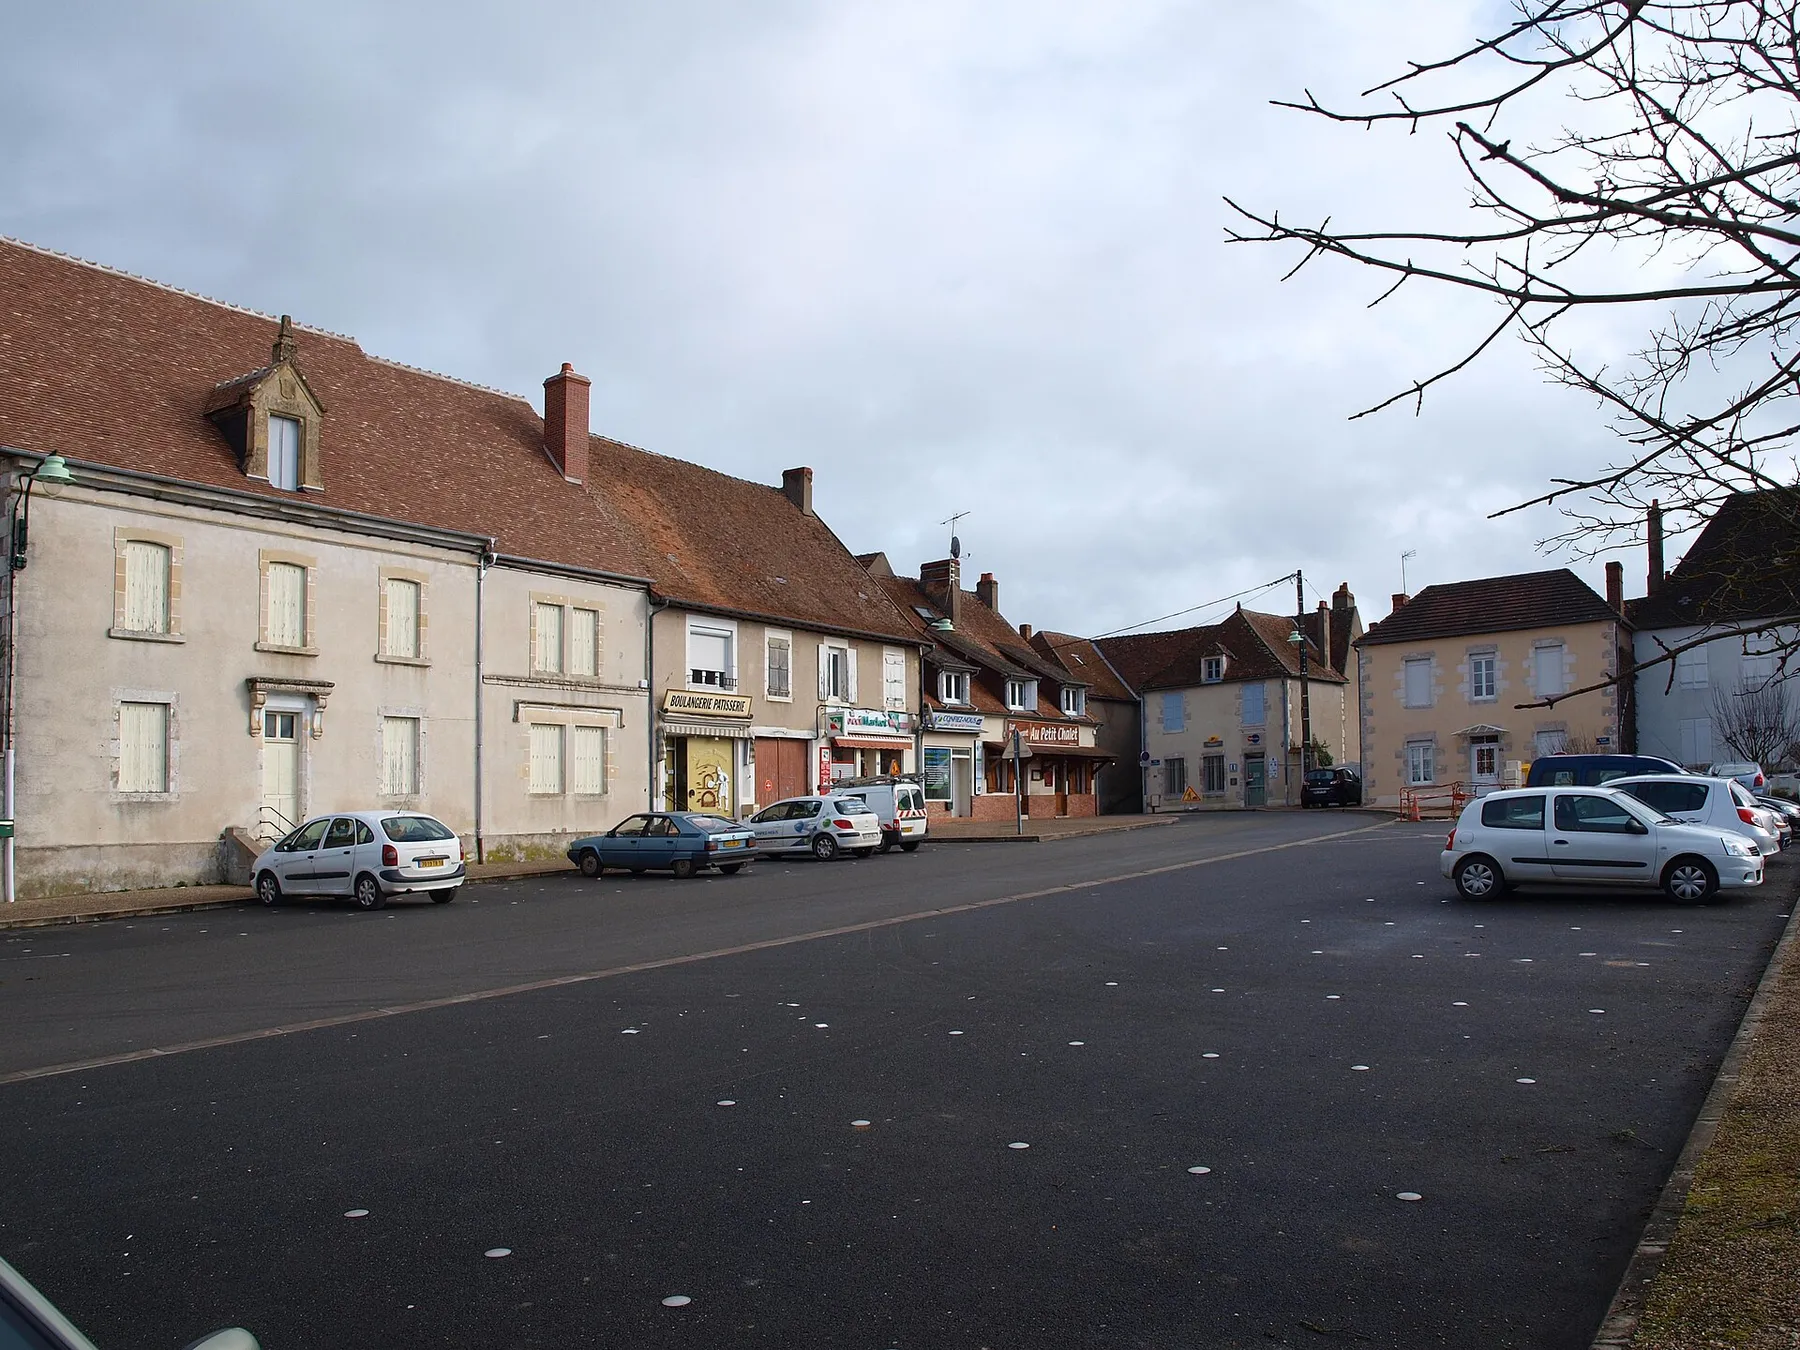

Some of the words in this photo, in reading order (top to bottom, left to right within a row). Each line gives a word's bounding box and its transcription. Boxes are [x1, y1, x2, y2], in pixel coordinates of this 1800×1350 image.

[670, 695, 712, 709] BOULANGERIE
[713, 699, 745, 712] PATISSERIE
[1030, 727, 1039, 740] Au
[1041, 727, 1057, 740] Petit
[1058, 727, 1078, 740] Chalet
